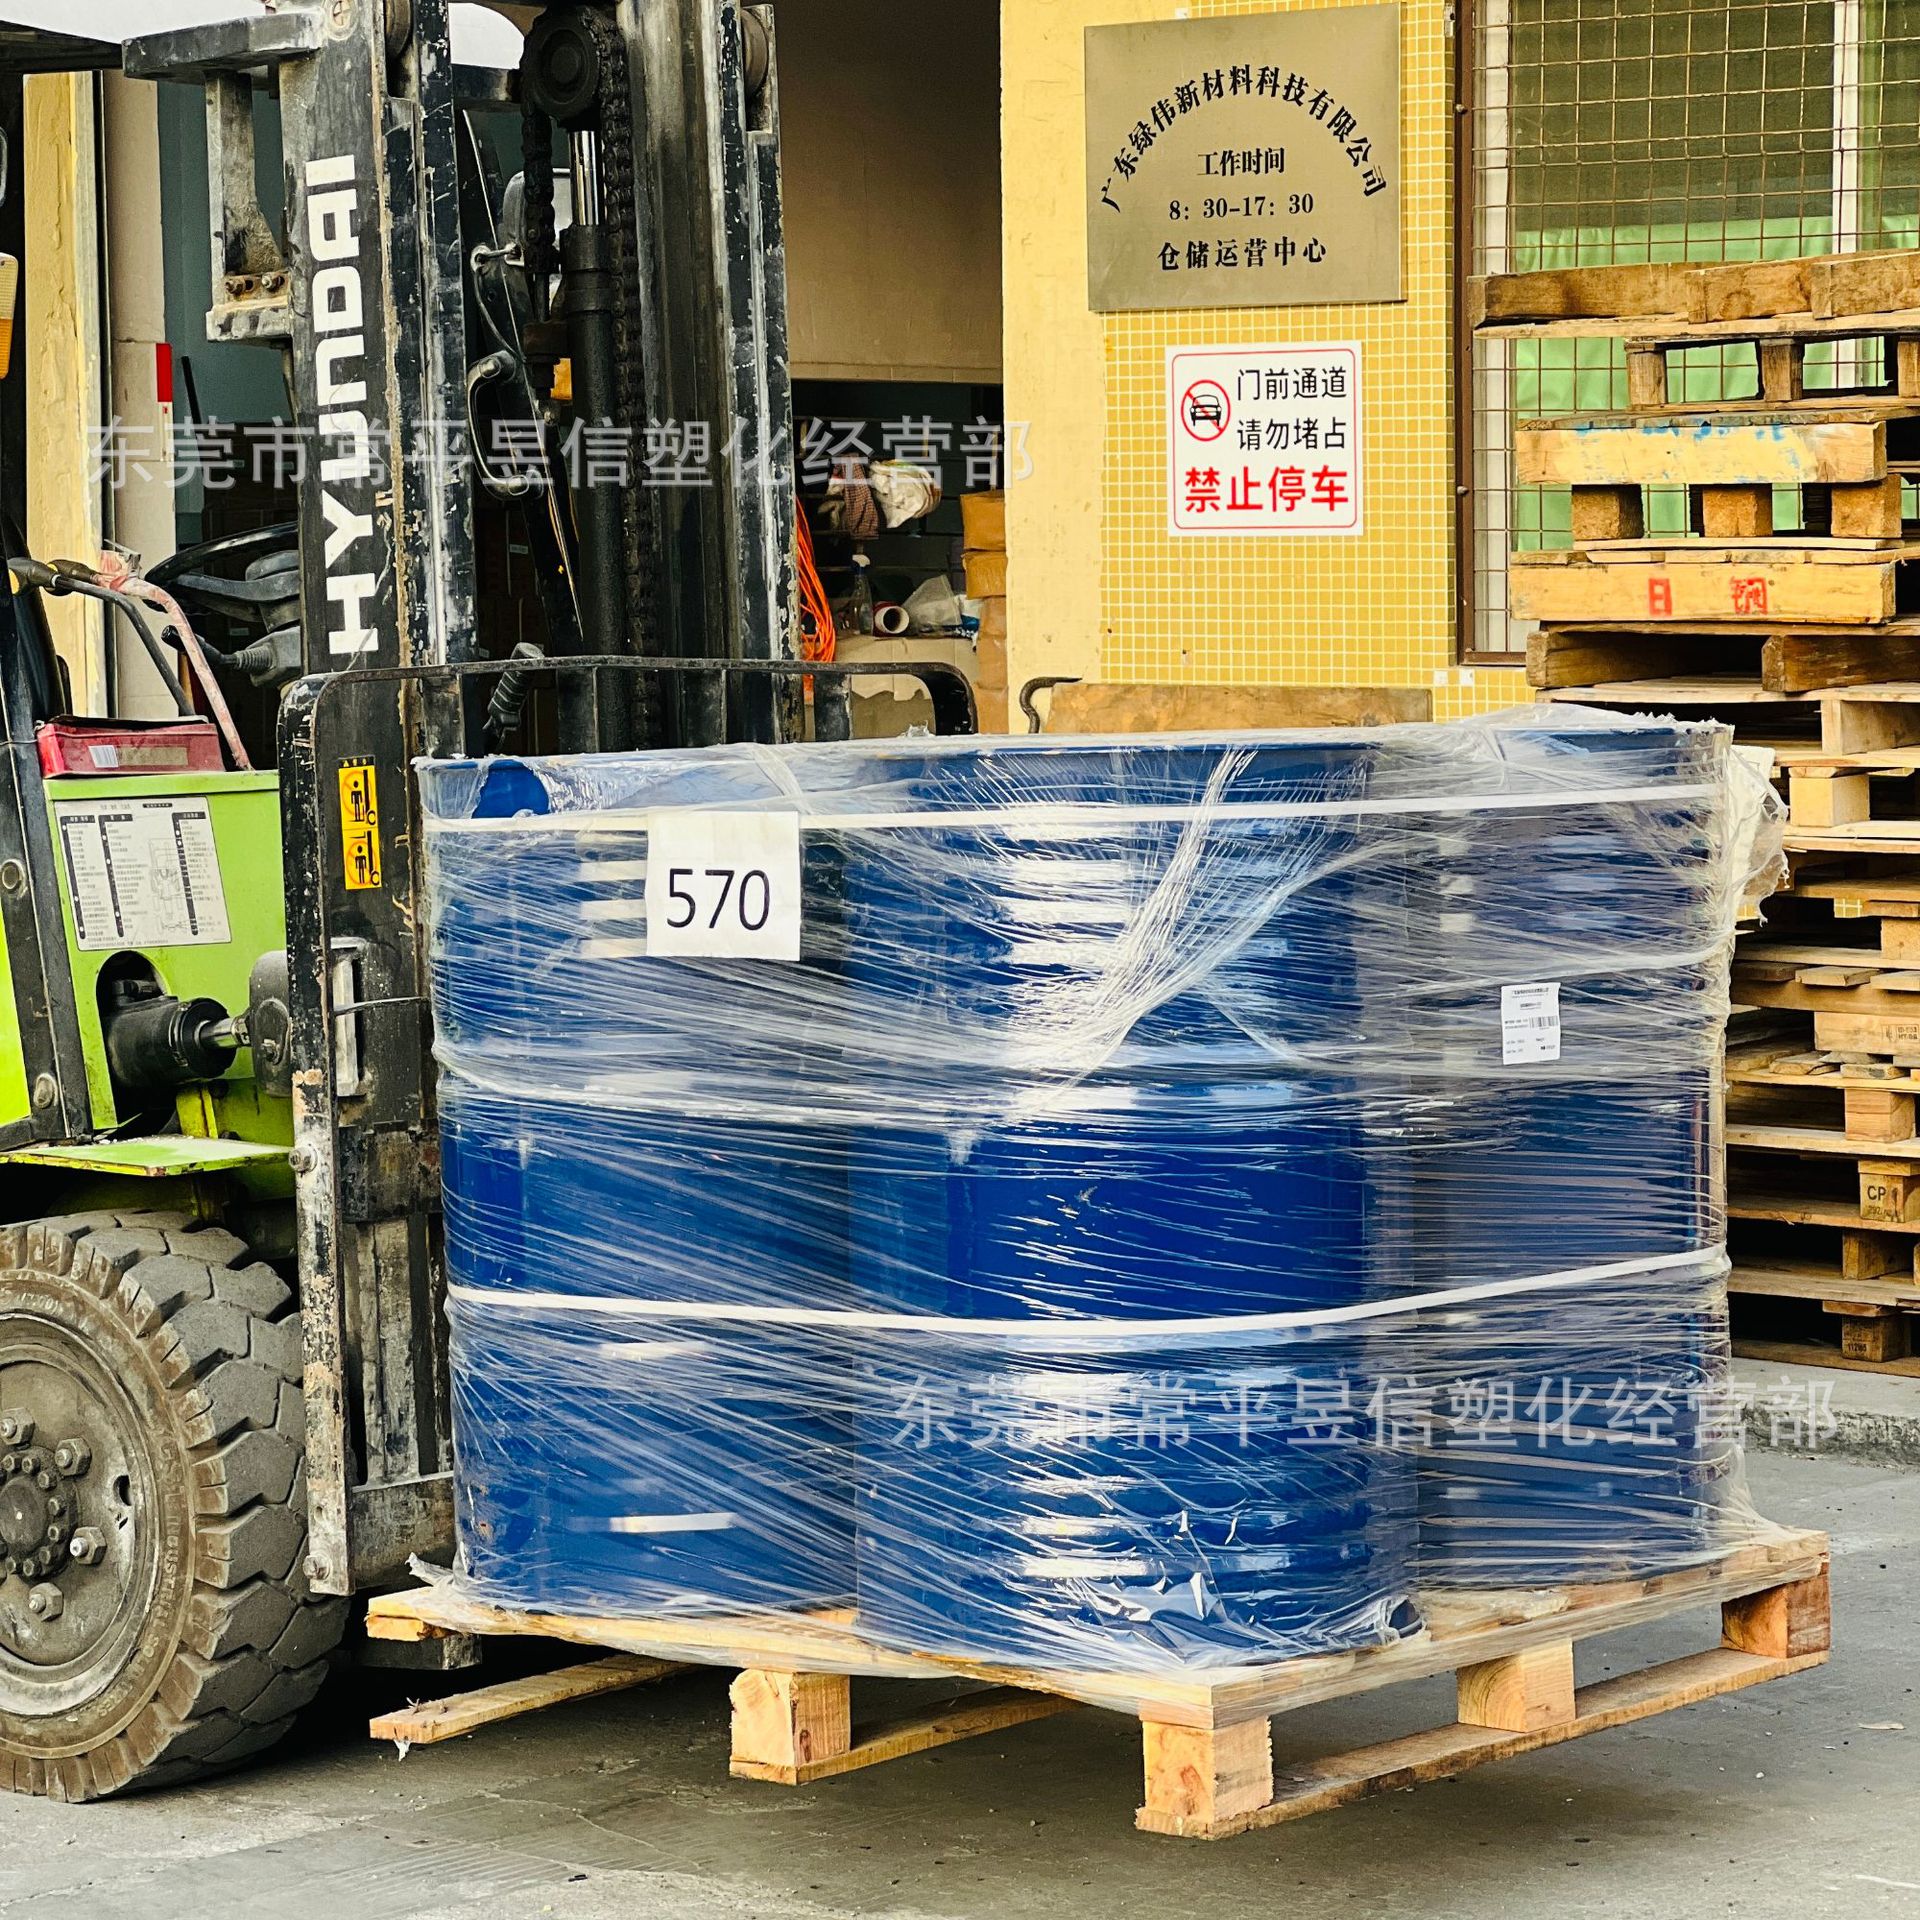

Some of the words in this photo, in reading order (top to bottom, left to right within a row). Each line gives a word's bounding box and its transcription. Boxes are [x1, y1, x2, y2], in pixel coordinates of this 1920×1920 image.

[1101, 64, 1387, 213] 广东绿伟新材料科技有限公司
[1197, 147, 1286, 176] 工作时间
[1157, 235, 1327, 271] 仓储运营中心
[1236, 366, 1348, 402] 门前通道
[306, 154, 379, 656] HYUNDAI
[1236, 416, 1347, 452] 请勿堵占
[1184, 464, 1349, 513] 禁止停车
[667, 867, 771, 931] 570
[1867, 1185, 1887, 1201] CP
